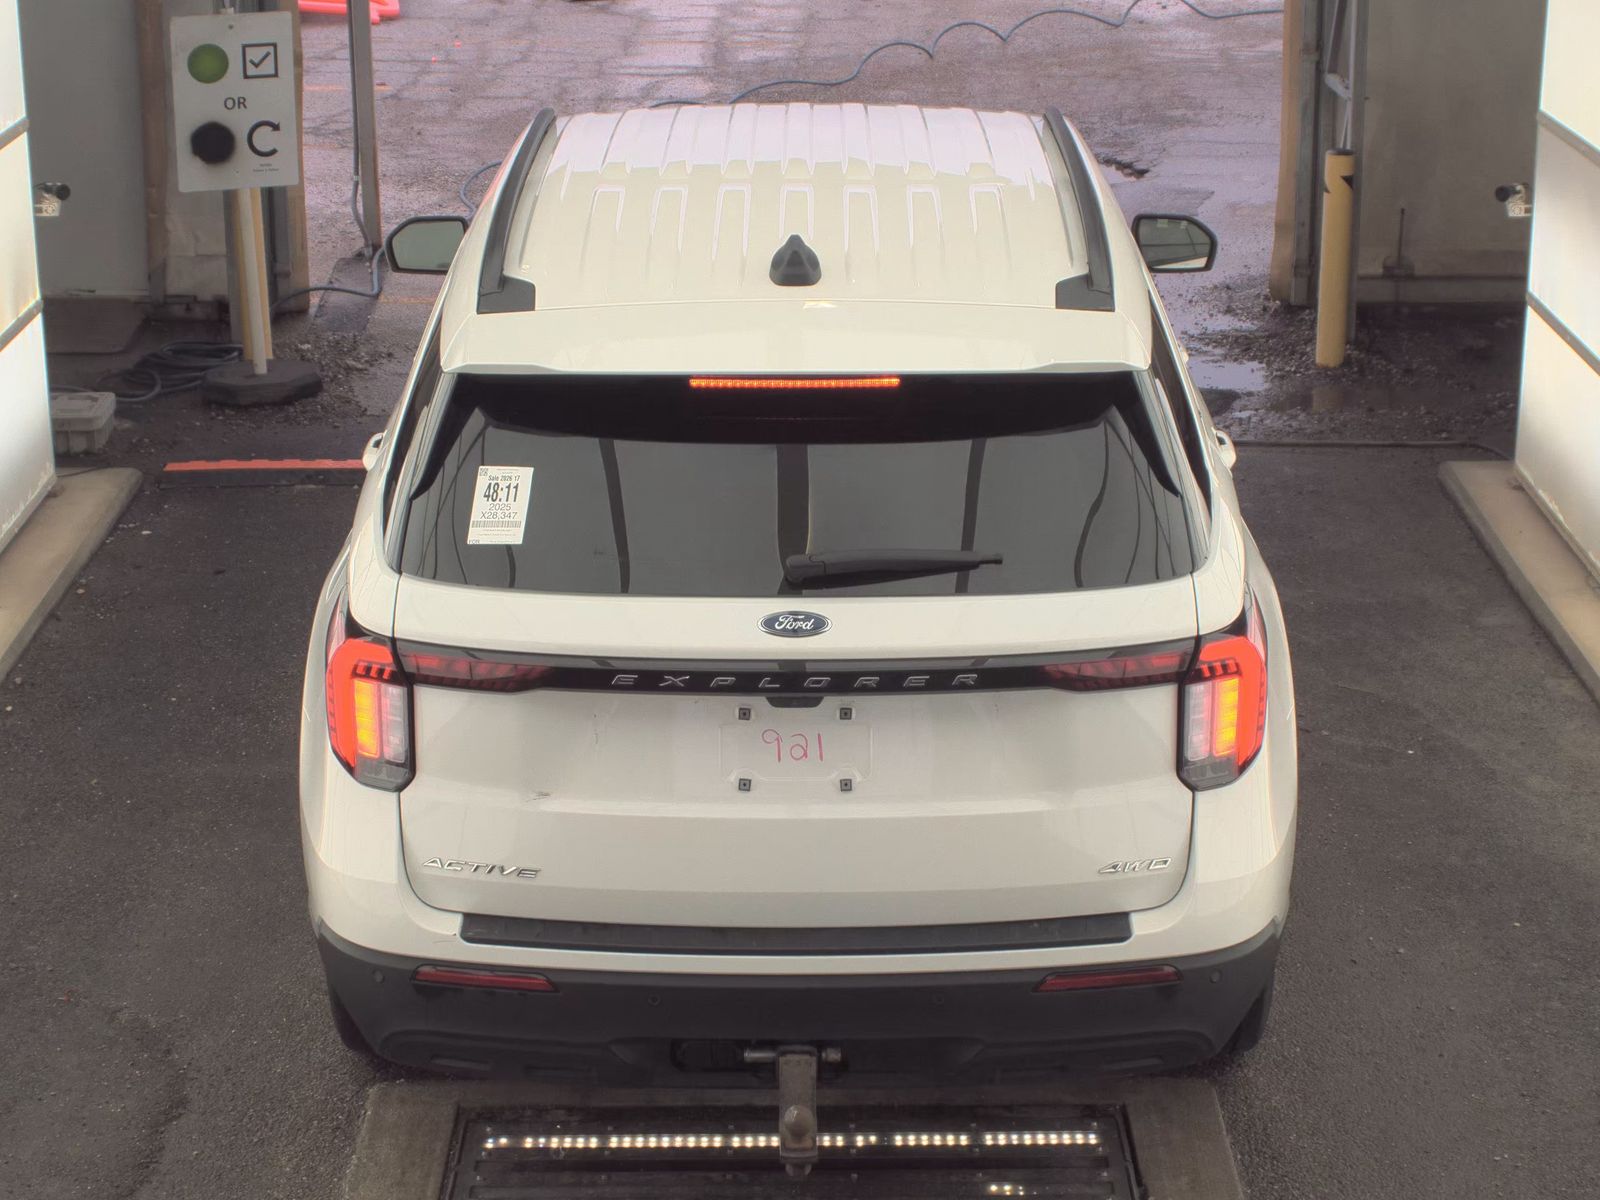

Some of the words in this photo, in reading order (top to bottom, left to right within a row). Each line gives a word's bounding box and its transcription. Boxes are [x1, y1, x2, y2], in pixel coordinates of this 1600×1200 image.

[223, 96, 248, 110] OR
[483, 482, 520, 502] 48:11
[480, 511, 518, 520] X28,347
[488, 502, 512, 511] 2025
[774, 613, 815, 631] Ford
[611, 673, 979, 689] EXPLORER
[761, 728, 824, 763] 921
[422, 857, 541, 879] ACTIVE
[1098, 857, 1172, 875] 4WD
